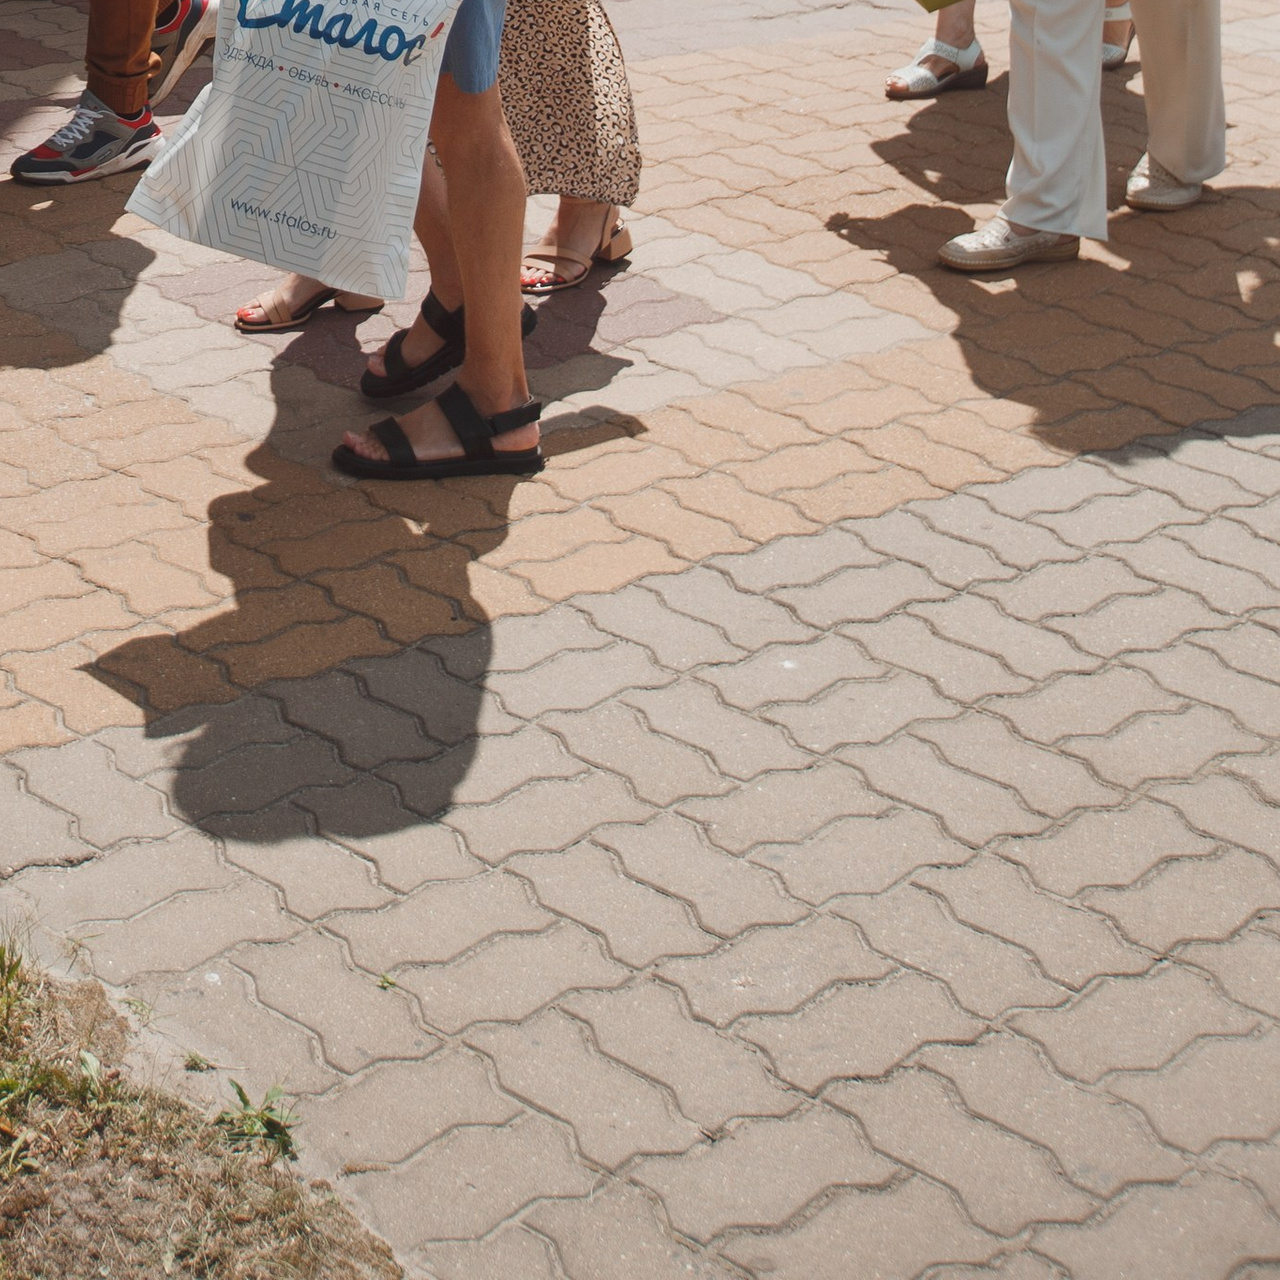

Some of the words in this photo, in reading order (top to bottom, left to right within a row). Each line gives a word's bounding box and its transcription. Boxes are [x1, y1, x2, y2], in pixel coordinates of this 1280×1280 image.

[389, 7, 429, 27] СЕТЬ
[288, 66, 329, 88] ОБУВЬ
[230, 197, 337, 240] www.stalos.ru
